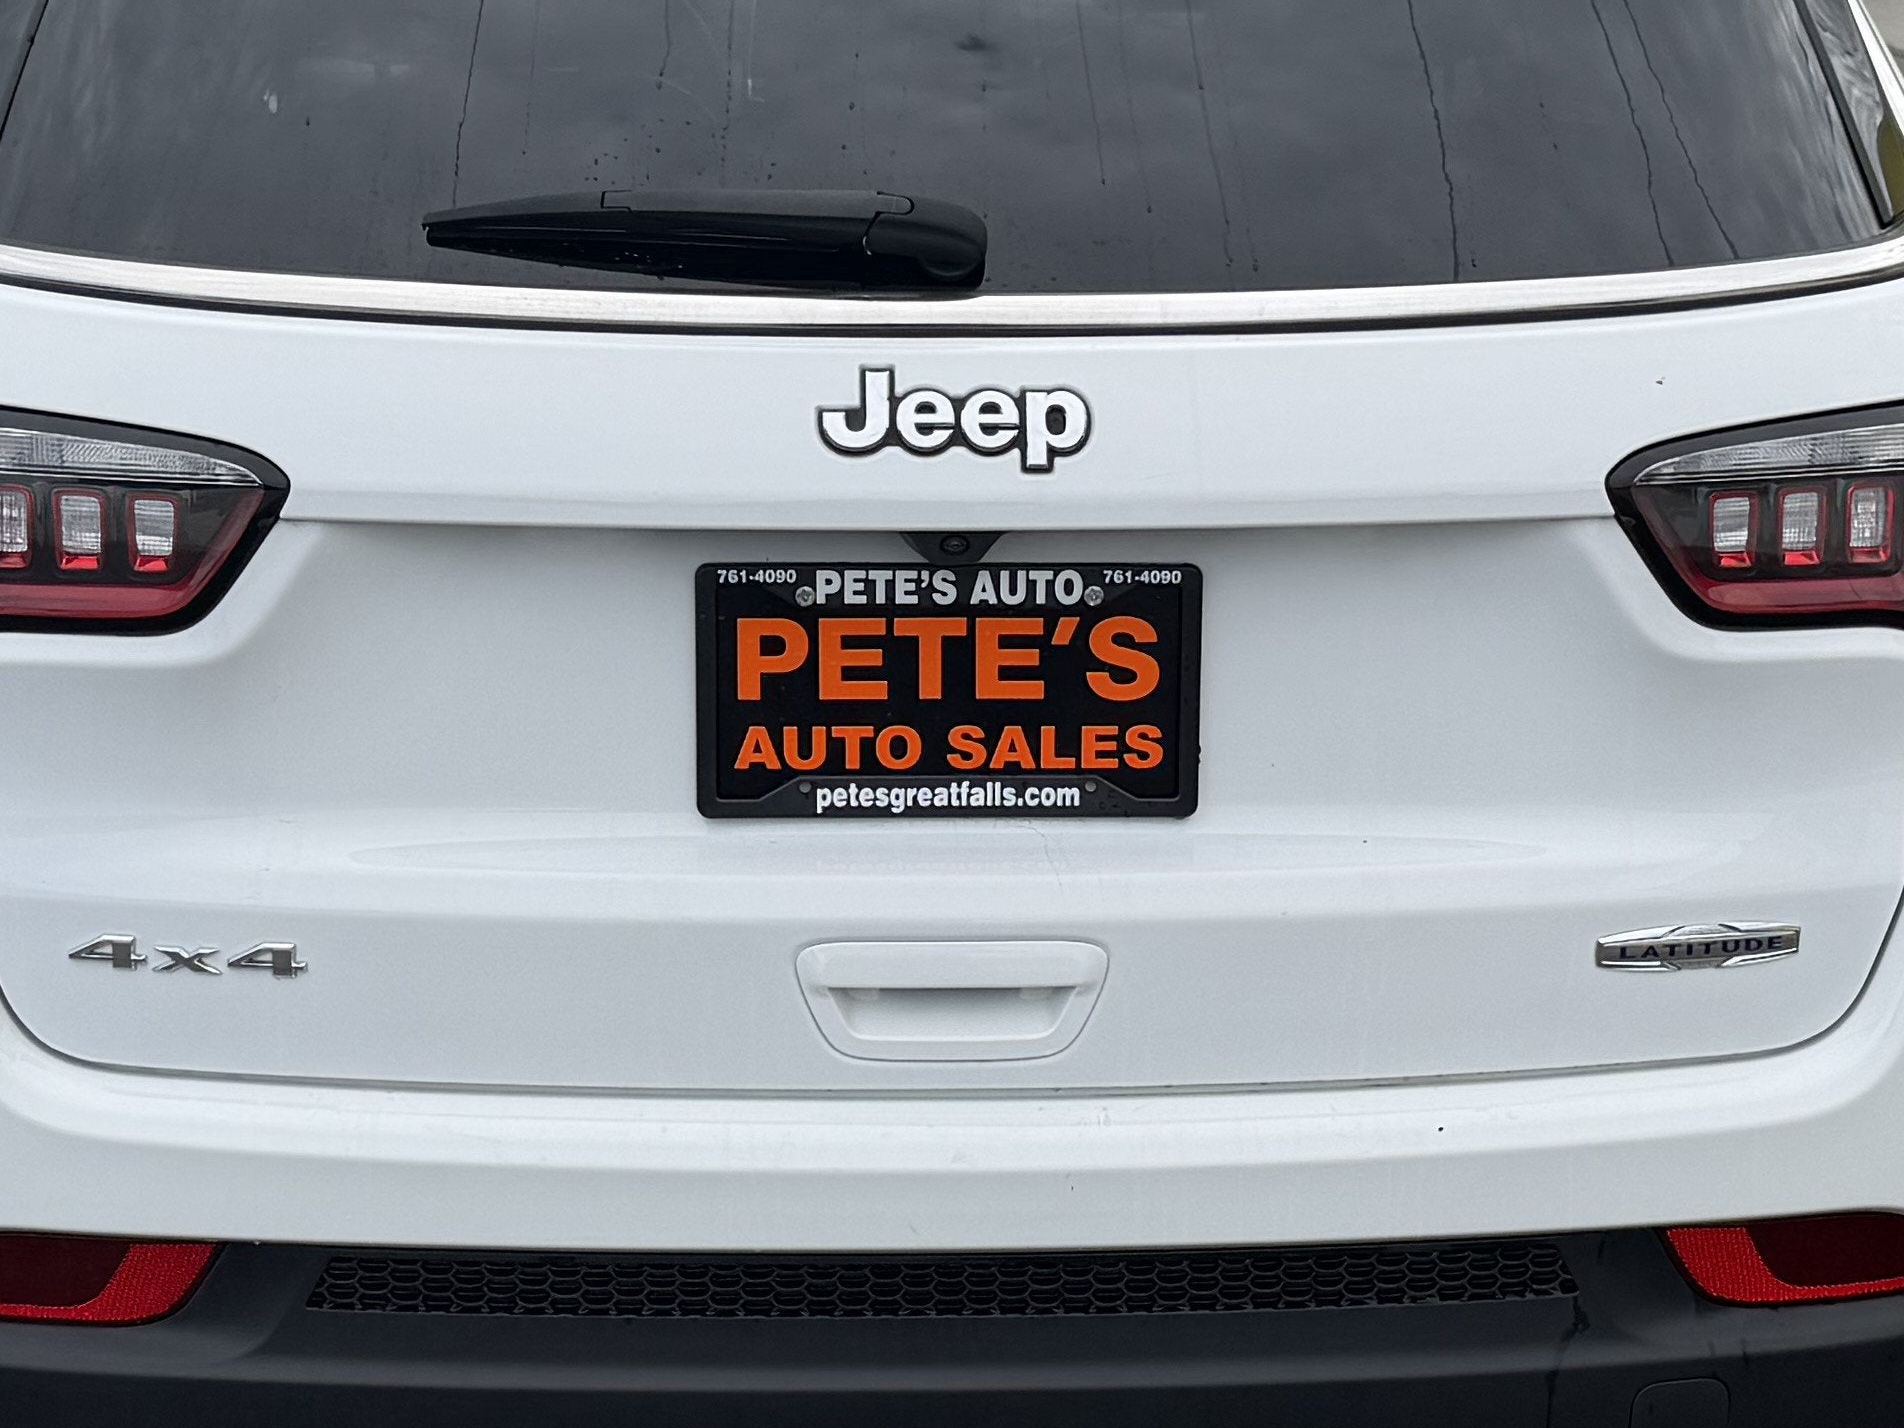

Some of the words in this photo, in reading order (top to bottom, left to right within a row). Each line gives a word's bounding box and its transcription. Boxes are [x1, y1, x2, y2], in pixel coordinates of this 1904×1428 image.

[818, 367, 1091, 473] Jeep
[717, 569, 797, 584] 761-4090
[815, 569, 958, 605] PETE'S
[970, 569, 1084, 605] AUTO
[1103, 569, 1182, 584] 761-4090
[737, 615, 1160, 702] PETE'S
[735, 725, 922, 770] AUTO
[947, 724, 1164, 770] SALES
[816, 781, 1081, 814] petesgreatfalls.com
[1619, 935, 1783, 960] LATITUDE
